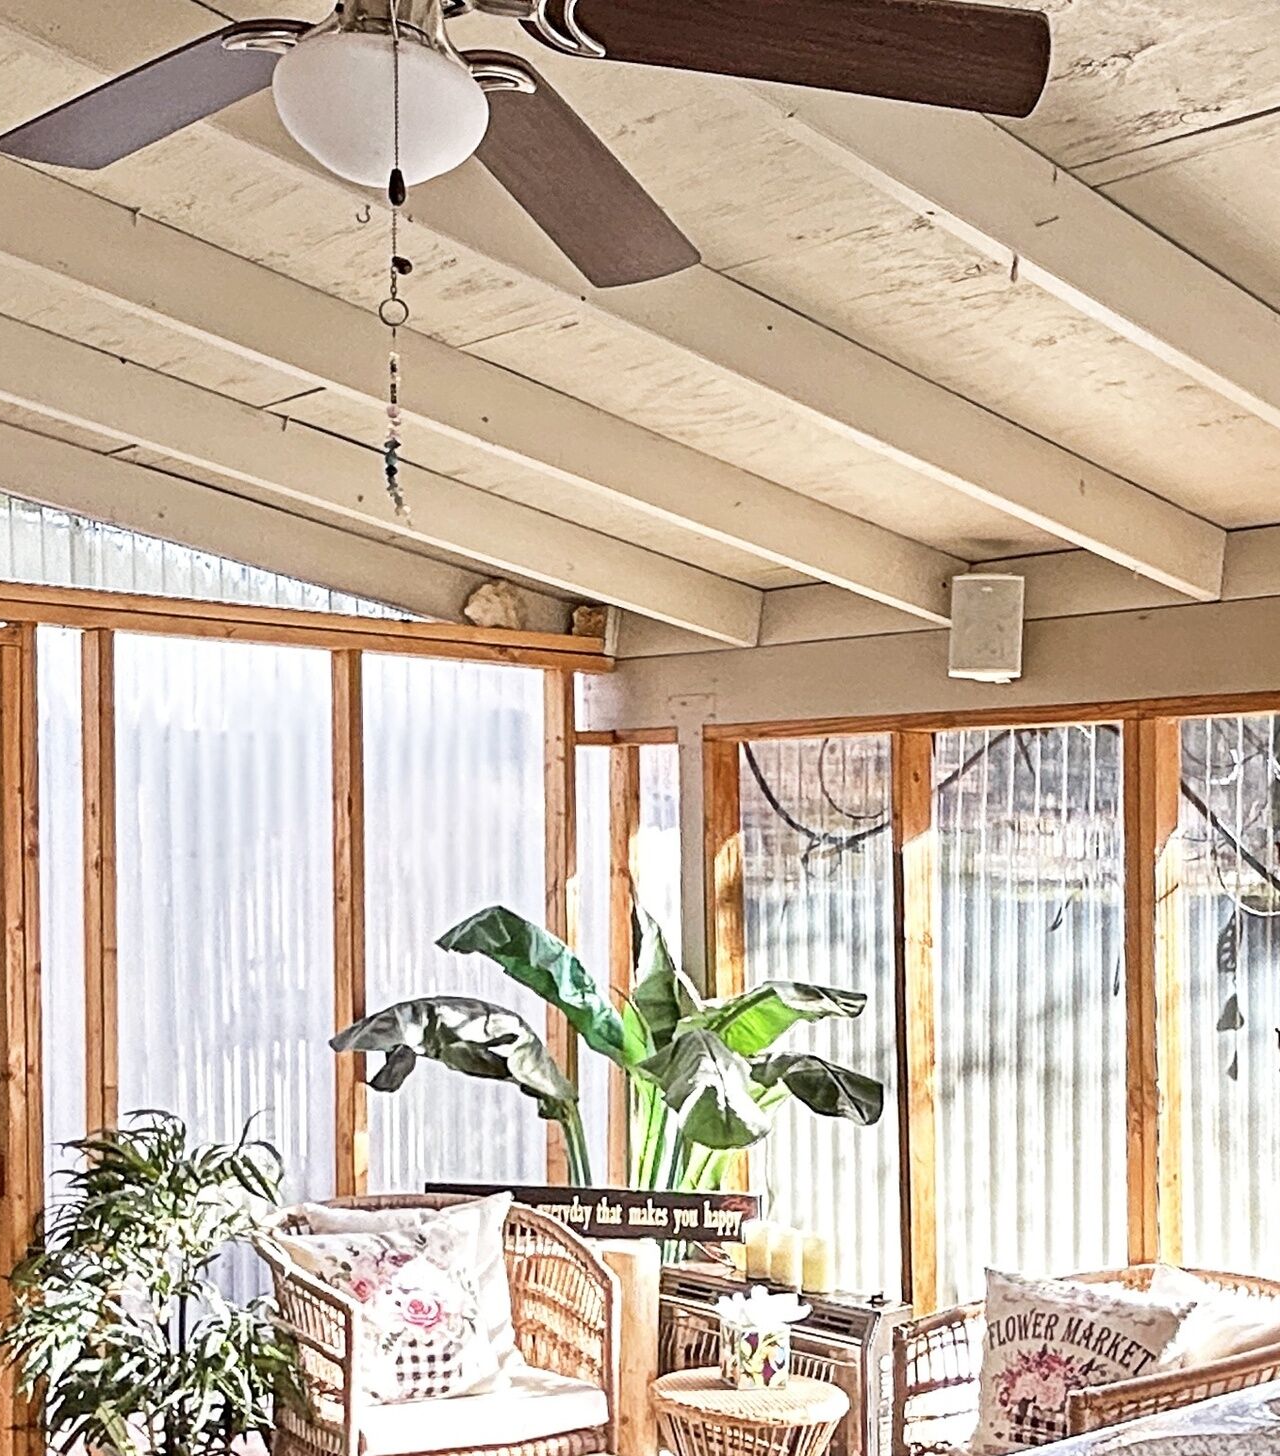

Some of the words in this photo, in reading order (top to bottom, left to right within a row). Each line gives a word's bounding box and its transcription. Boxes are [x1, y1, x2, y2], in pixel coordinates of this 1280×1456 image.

[537, 1195, 592, 1230] eryday
[596, 1196, 622, 1225] that
[628, 1198, 669, 1227] makes
[673, 1208, 699, 1235] you
[703, 1200, 742, 1237] happy
[987, 1308, 1059, 1350] FLOWER
[1061, 1317, 1157, 1376] MARKET
